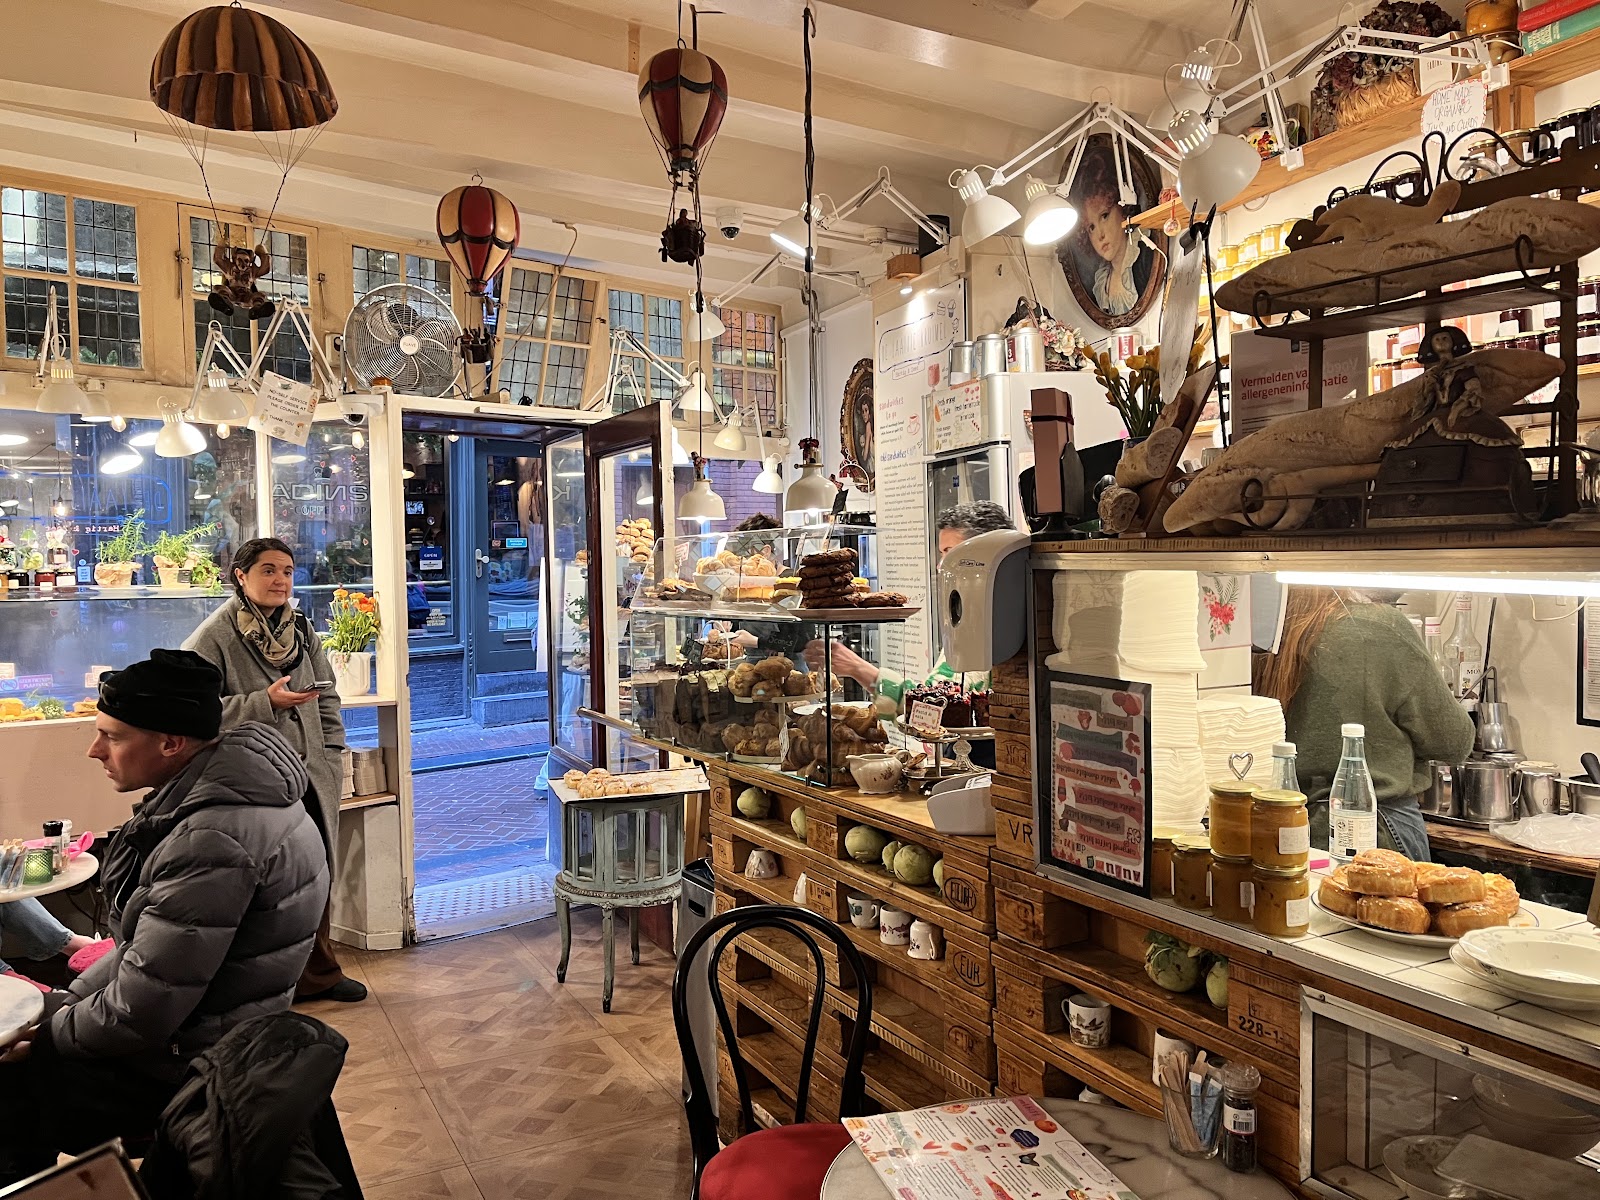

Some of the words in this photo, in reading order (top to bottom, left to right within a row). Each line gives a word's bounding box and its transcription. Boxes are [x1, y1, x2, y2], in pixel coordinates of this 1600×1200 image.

[1241, 371, 1294, 388] Vermelden
[1295, 369, 1308, 380] va
[1241, 374, 1349, 400] allergeneninfomatie
[267, 395, 283, 403] PLEASE
[284, 401, 299, 409] ORDER
[290, 396, 308, 405] SERVICE
[279, 406, 300, 415] COUNTER
[269, 415, 284, 423] THANK
[1056, 763, 1076, 774] matcha
[1075, 768, 1100, 780] chocolate
[1100, 774, 1117, 784] white
[1106, 821, 1121, 832] dark
[1008, 819, 1034, 847] VR
[1079, 833, 1094, 845] latte
[1093, 839, 1112, 850] toffee
[1112, 843, 1137, 856] caramel
[959, 955, 980, 984] EUR
